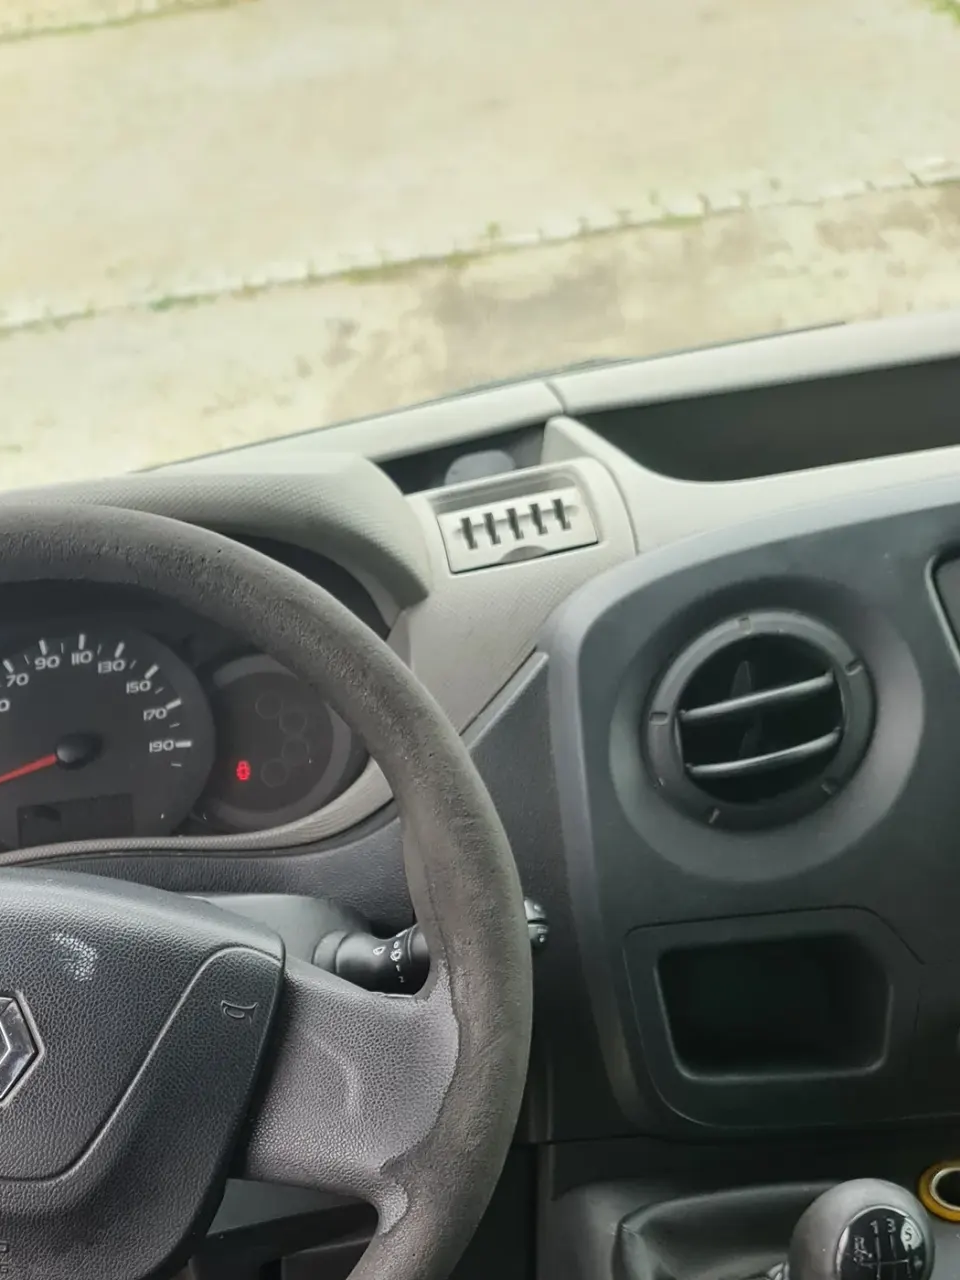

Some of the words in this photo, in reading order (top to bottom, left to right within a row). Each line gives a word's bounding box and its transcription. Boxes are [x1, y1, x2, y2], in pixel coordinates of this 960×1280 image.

[34, 655, 60, 671] 90
[71, 650, 93, 666] 110
[97, 659, 126, 674] 130
[6, 672, 29, 688] 70
[126, 680, 151, 694] 150
[143, 706, 167, 721] 170
[149, 739, 175, 753] 190
[870, 1220, 878, 1234] 1
[886, 1218, 896, 1233] 3
